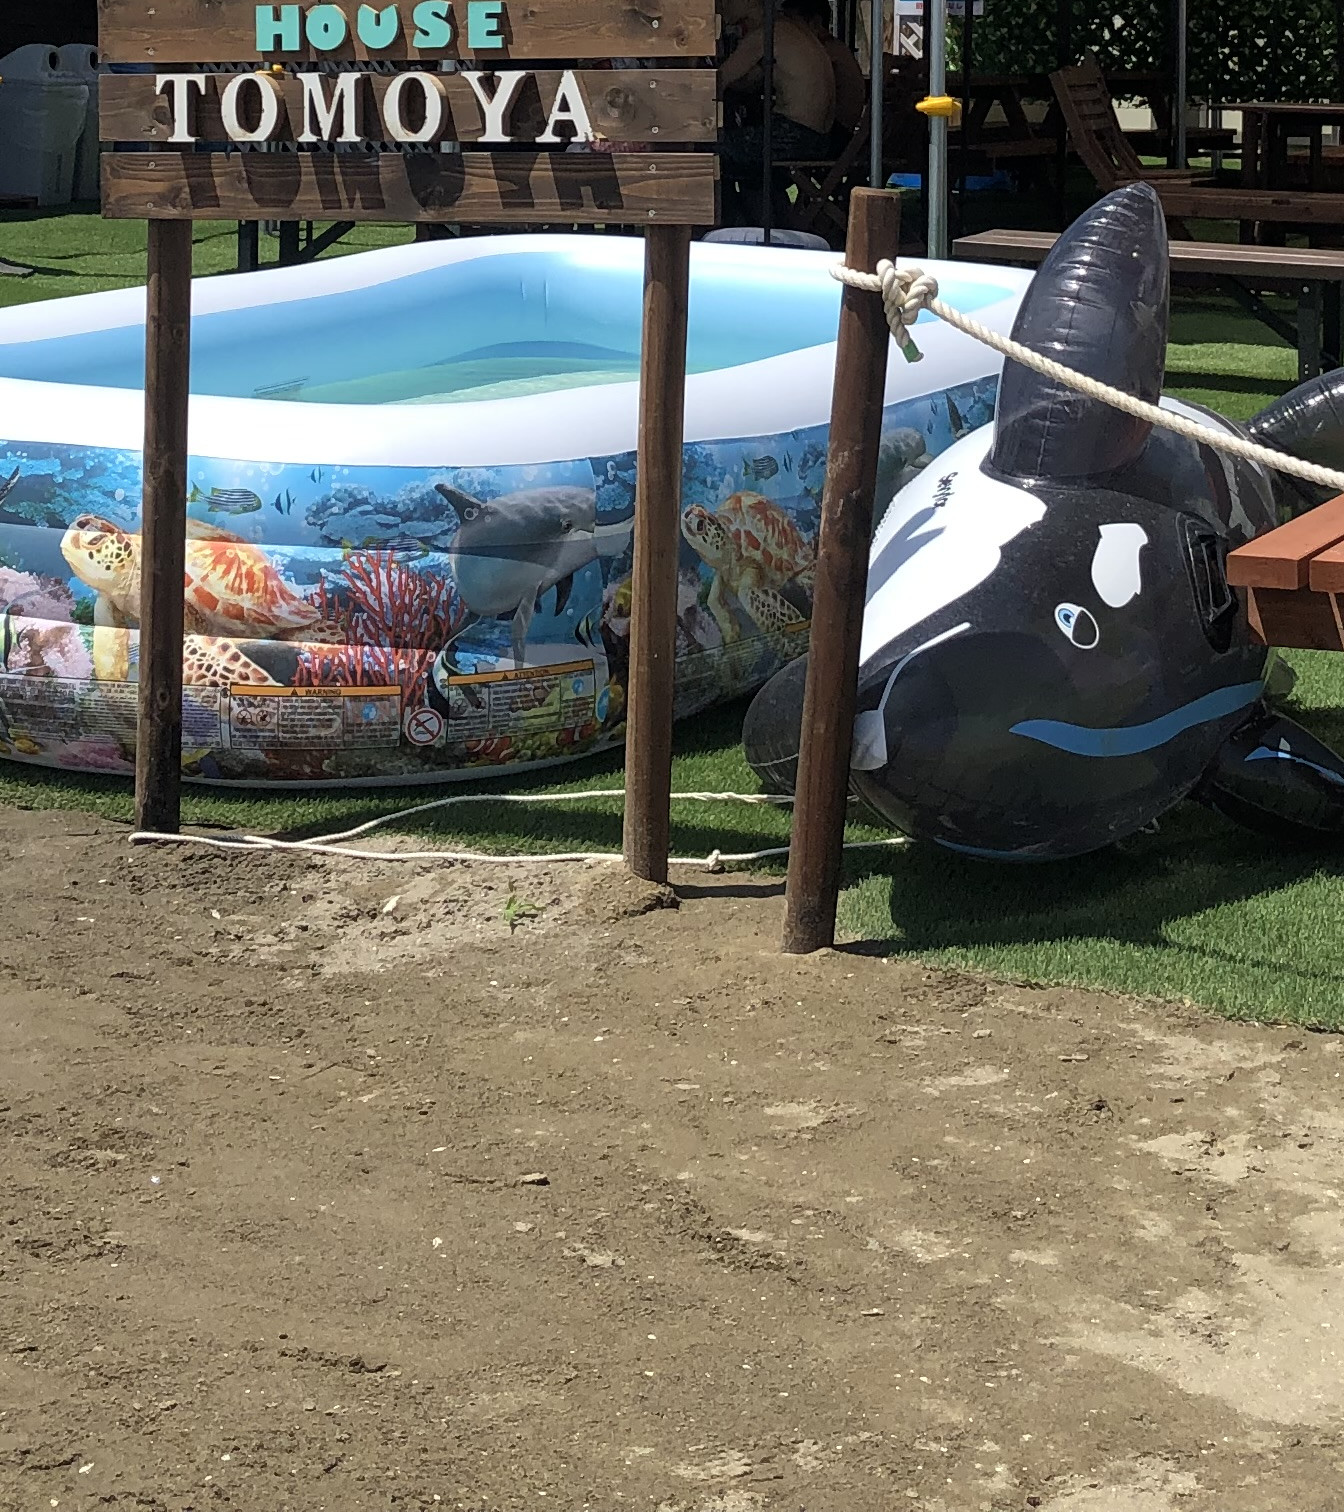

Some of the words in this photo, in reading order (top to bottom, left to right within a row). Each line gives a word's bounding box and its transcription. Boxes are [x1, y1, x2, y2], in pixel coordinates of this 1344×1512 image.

[256, 0, 504, 52] HOUSE
[156, 70, 595, 143] TOMOYA
[305, 688, 342, 696] WARNING
